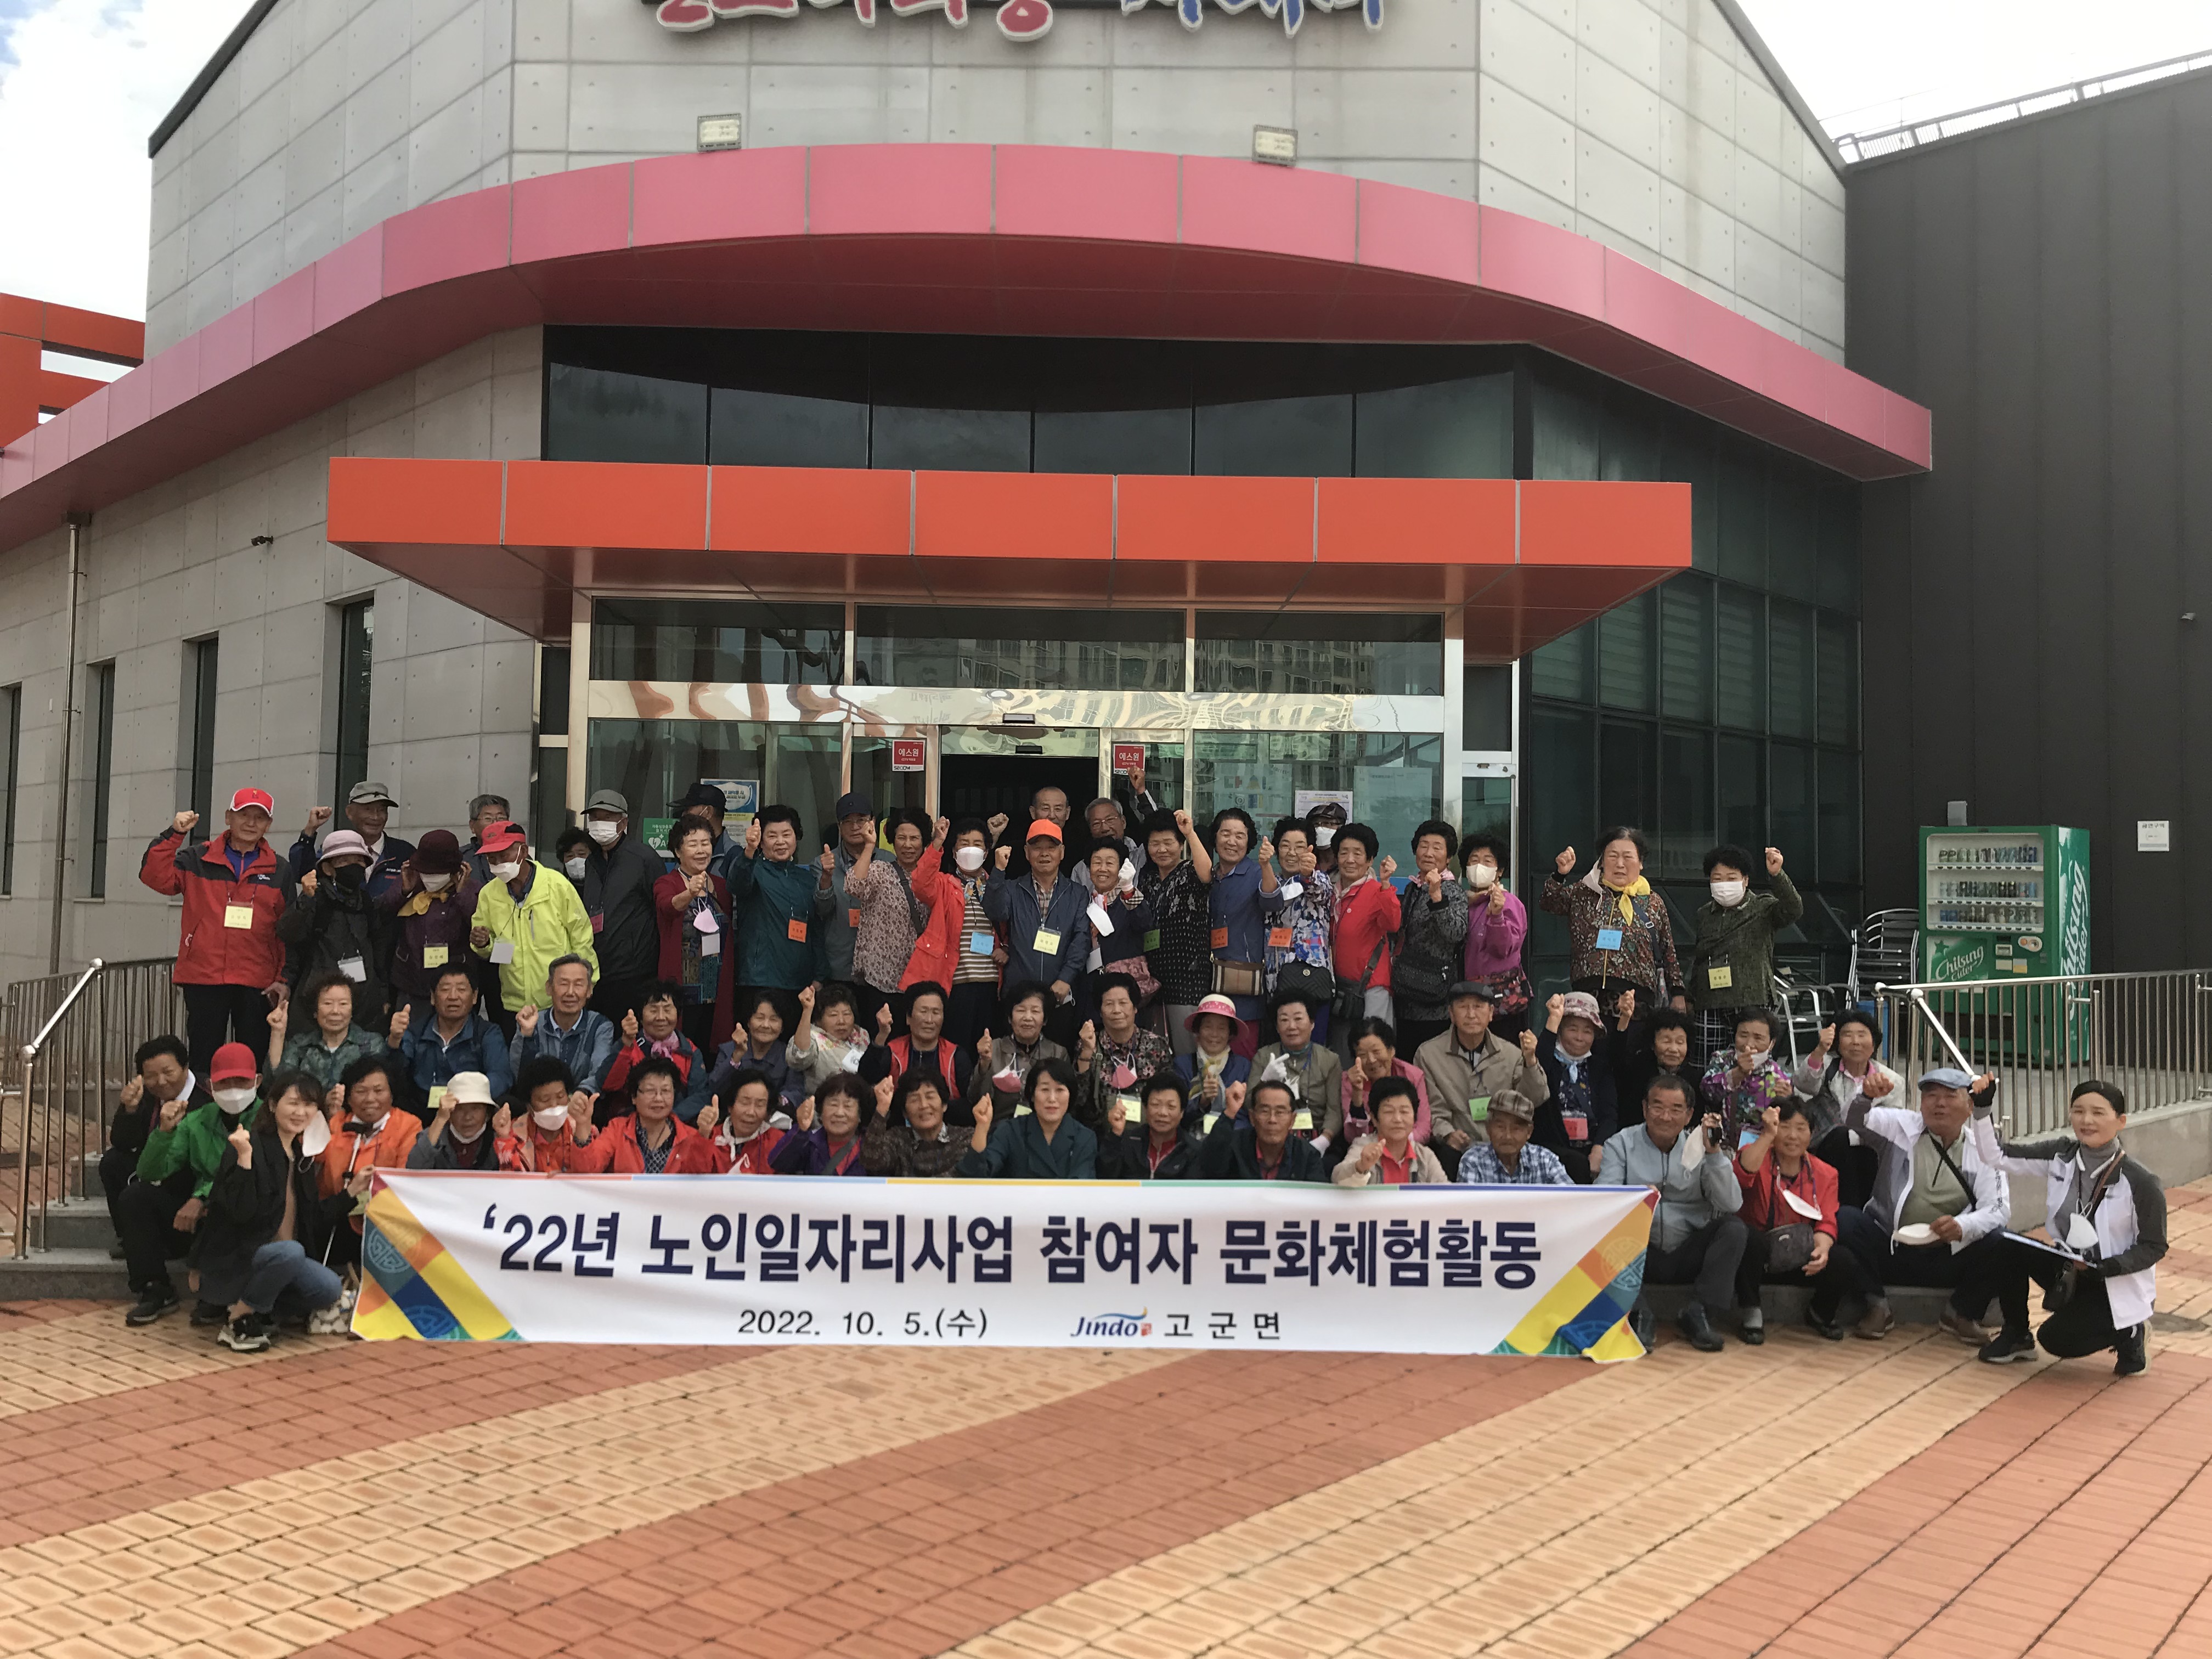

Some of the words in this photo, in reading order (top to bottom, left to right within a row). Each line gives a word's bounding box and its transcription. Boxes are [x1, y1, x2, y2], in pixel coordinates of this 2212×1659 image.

[898, 748, 919, 757] 에스원
[1119, 752, 1139, 761] 에스원
[1936, 946, 1984, 981] Chilsung
[641, 1212, 1013, 1284] 노인일자리사업
[1039, 1215, 1199, 1285] 참여자
[1219, 1218, 1542, 1290] 문화체험활동
[738, 1309, 820, 1335] 2022.
[843, 1311, 883, 1336] 10.
[1070, 1317, 1139, 1336] Jindo
